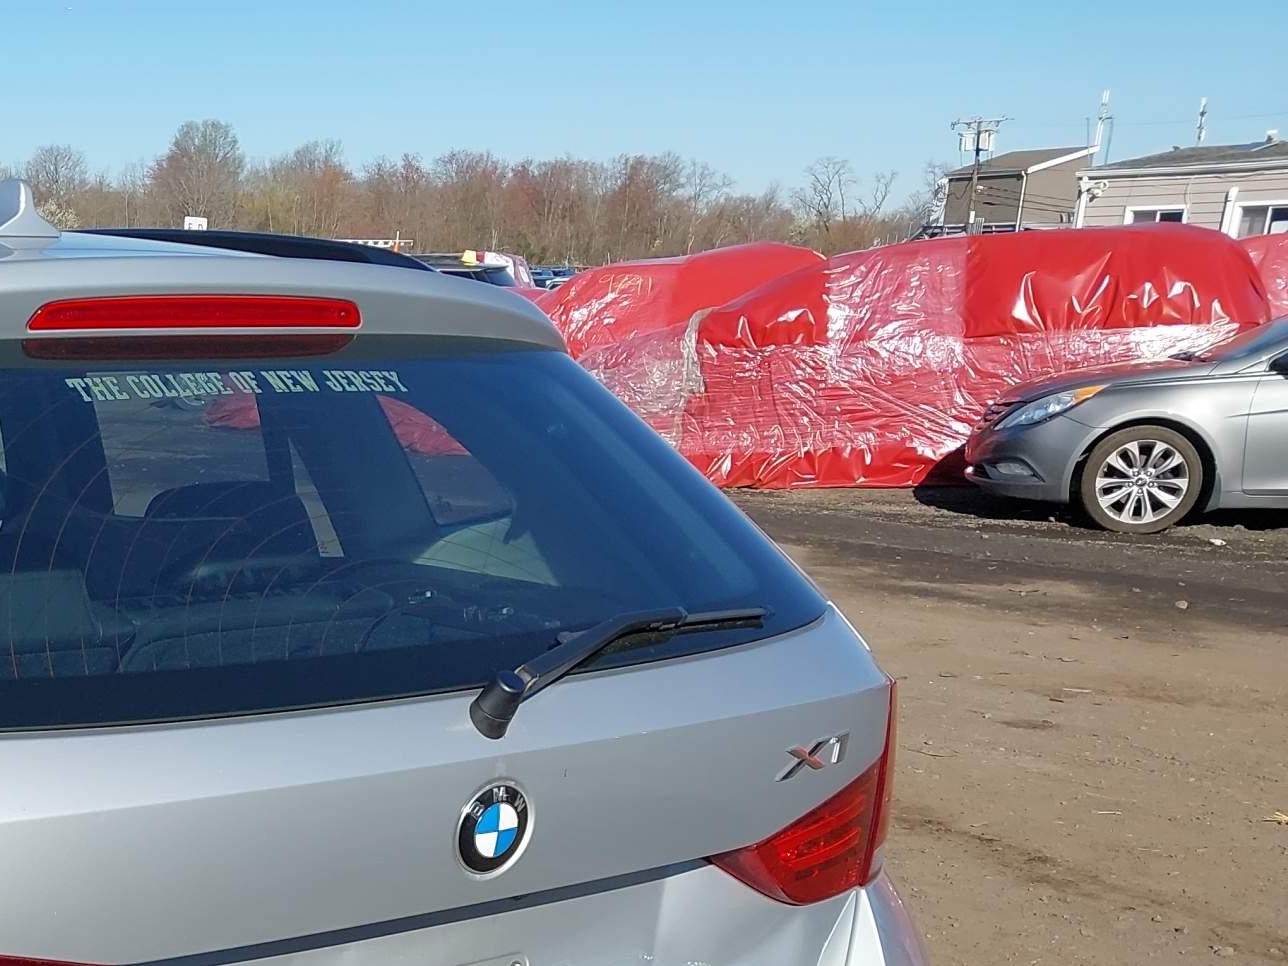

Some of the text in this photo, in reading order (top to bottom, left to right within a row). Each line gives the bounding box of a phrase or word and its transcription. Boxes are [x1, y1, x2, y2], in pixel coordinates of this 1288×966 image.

[65, 370, 409, 402] THE COLLEGE OF NEW JERSEY
[775, 730, 850, 782] X1
[469, 786, 526, 820] BMW
